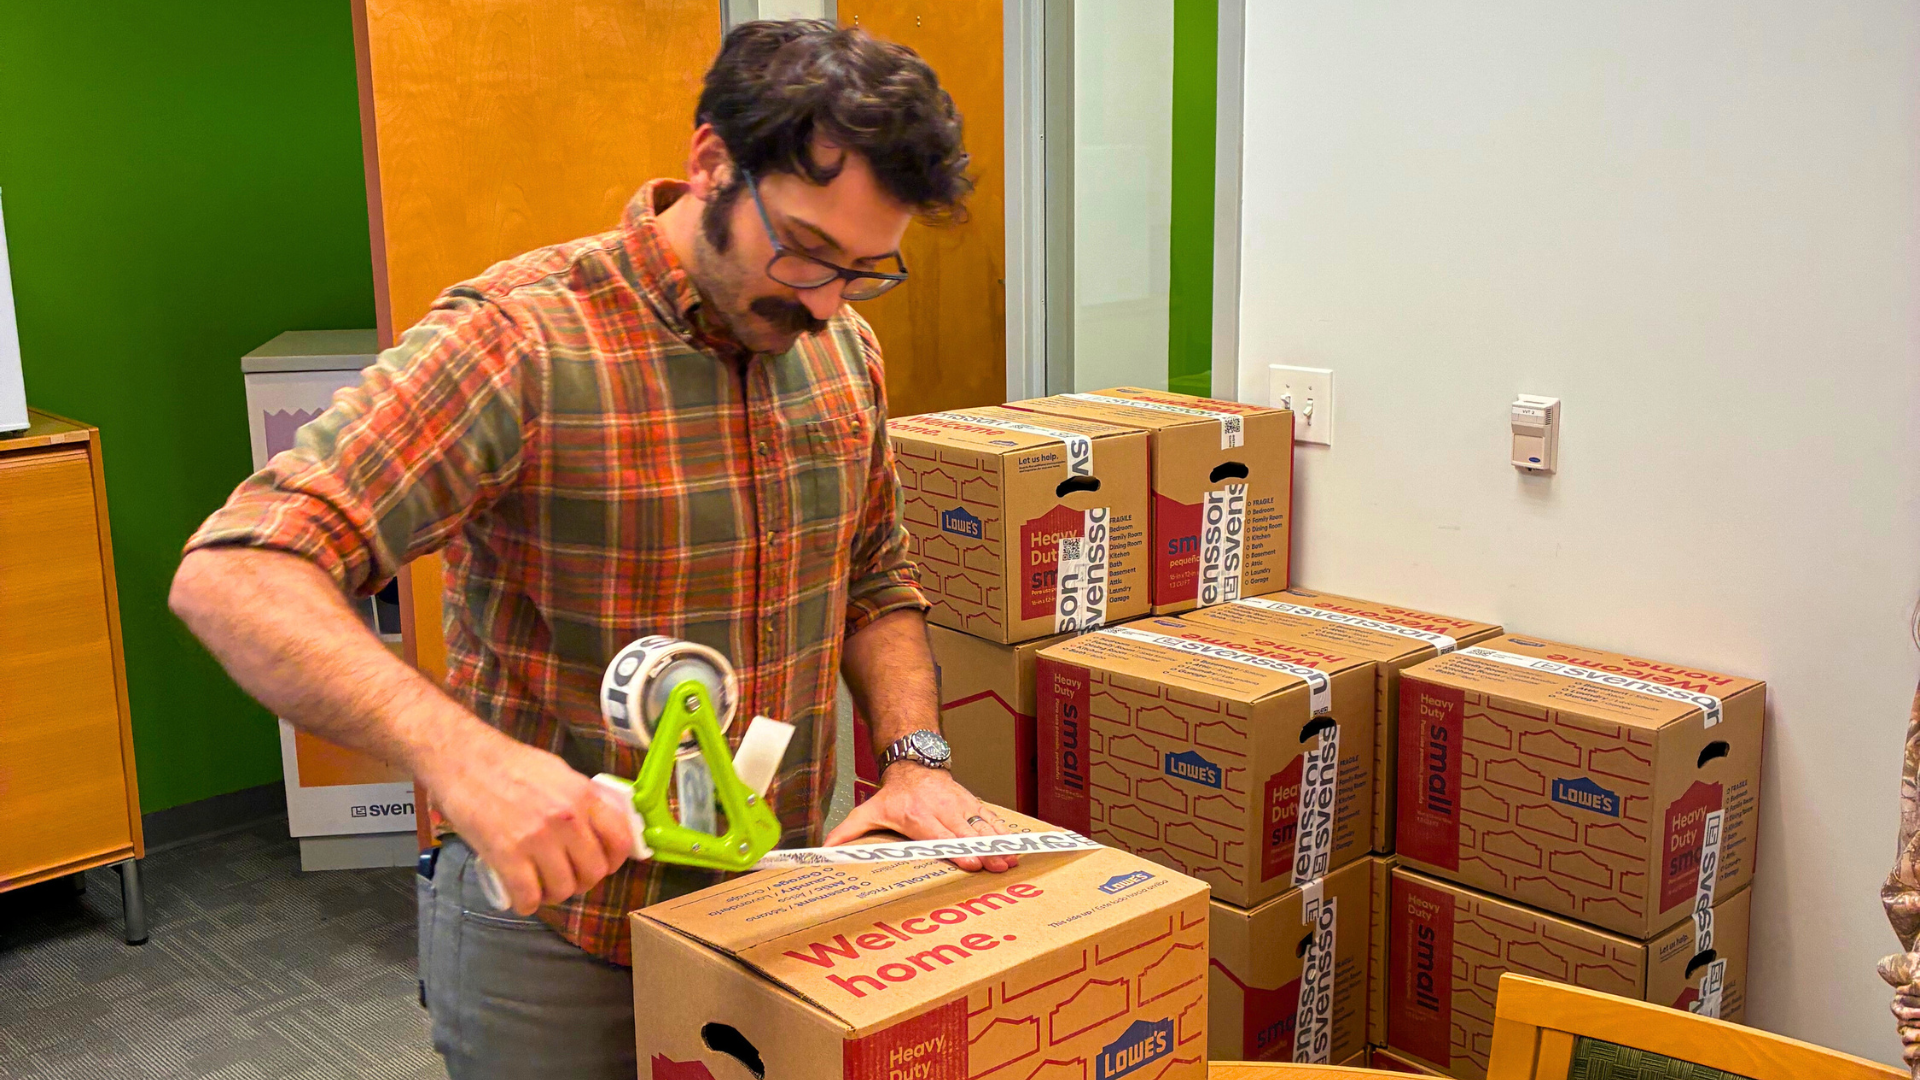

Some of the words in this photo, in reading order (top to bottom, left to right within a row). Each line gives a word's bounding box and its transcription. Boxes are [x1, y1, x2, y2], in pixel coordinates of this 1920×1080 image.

[908, 416, 1005, 436] Welcome
[1018, 457, 1030, 465] Let
[946, 514, 978, 536] LOWE'S
[1296, 606, 1442, 642] svensson
[1314, 603, 1450, 635] Welcome
[1181, 633, 1320, 669] Welcome
[1253, 638, 1347, 664] home.
[1054, 673, 1081, 690] Heavy
[1182, 642, 1328, 696] svensson
[1547, 653, 1709, 694] Welcome
[1622, 658, 1735, 686] home.
[1054, 684, 1075, 699] Duty
[1420, 693, 1454, 711] Heavy
[1420, 705, 1445, 720] Duty
[1063, 703, 1083, 790] small
[1171, 757, 1216, 784] LOWE'S
[1428, 724, 1452, 815] small
[369, 803, 415, 816] sven
[1559, 783, 1612, 812] LOWE'S
[1672, 805, 1708, 833] Heavy
[1670, 828, 1698, 853] Duty
[772, 871, 822, 888] Garage
[781, 875, 835, 894] Laundry
[814, 880, 846, 892] Attic
[893, 869, 947, 888] FRAGILE
[1103, 873, 1149, 892] LOWE'S
[794, 885, 860, 907] Basement
[1408, 893, 1440, 913] Heavy
[1048, 920, 1067, 929] This
[1066, 914, 1081, 923] side
[1081, 910, 1092, 918] up
[1408, 904, 1432, 921] Duty
[782, 883, 1045, 969] Welcome
[826, 932, 1017, 998] home.
[1416, 923, 1439, 1012] small
[889, 1034, 945, 1069] Heavy
[1104, 1030, 1167, 1079] LOWE'S
